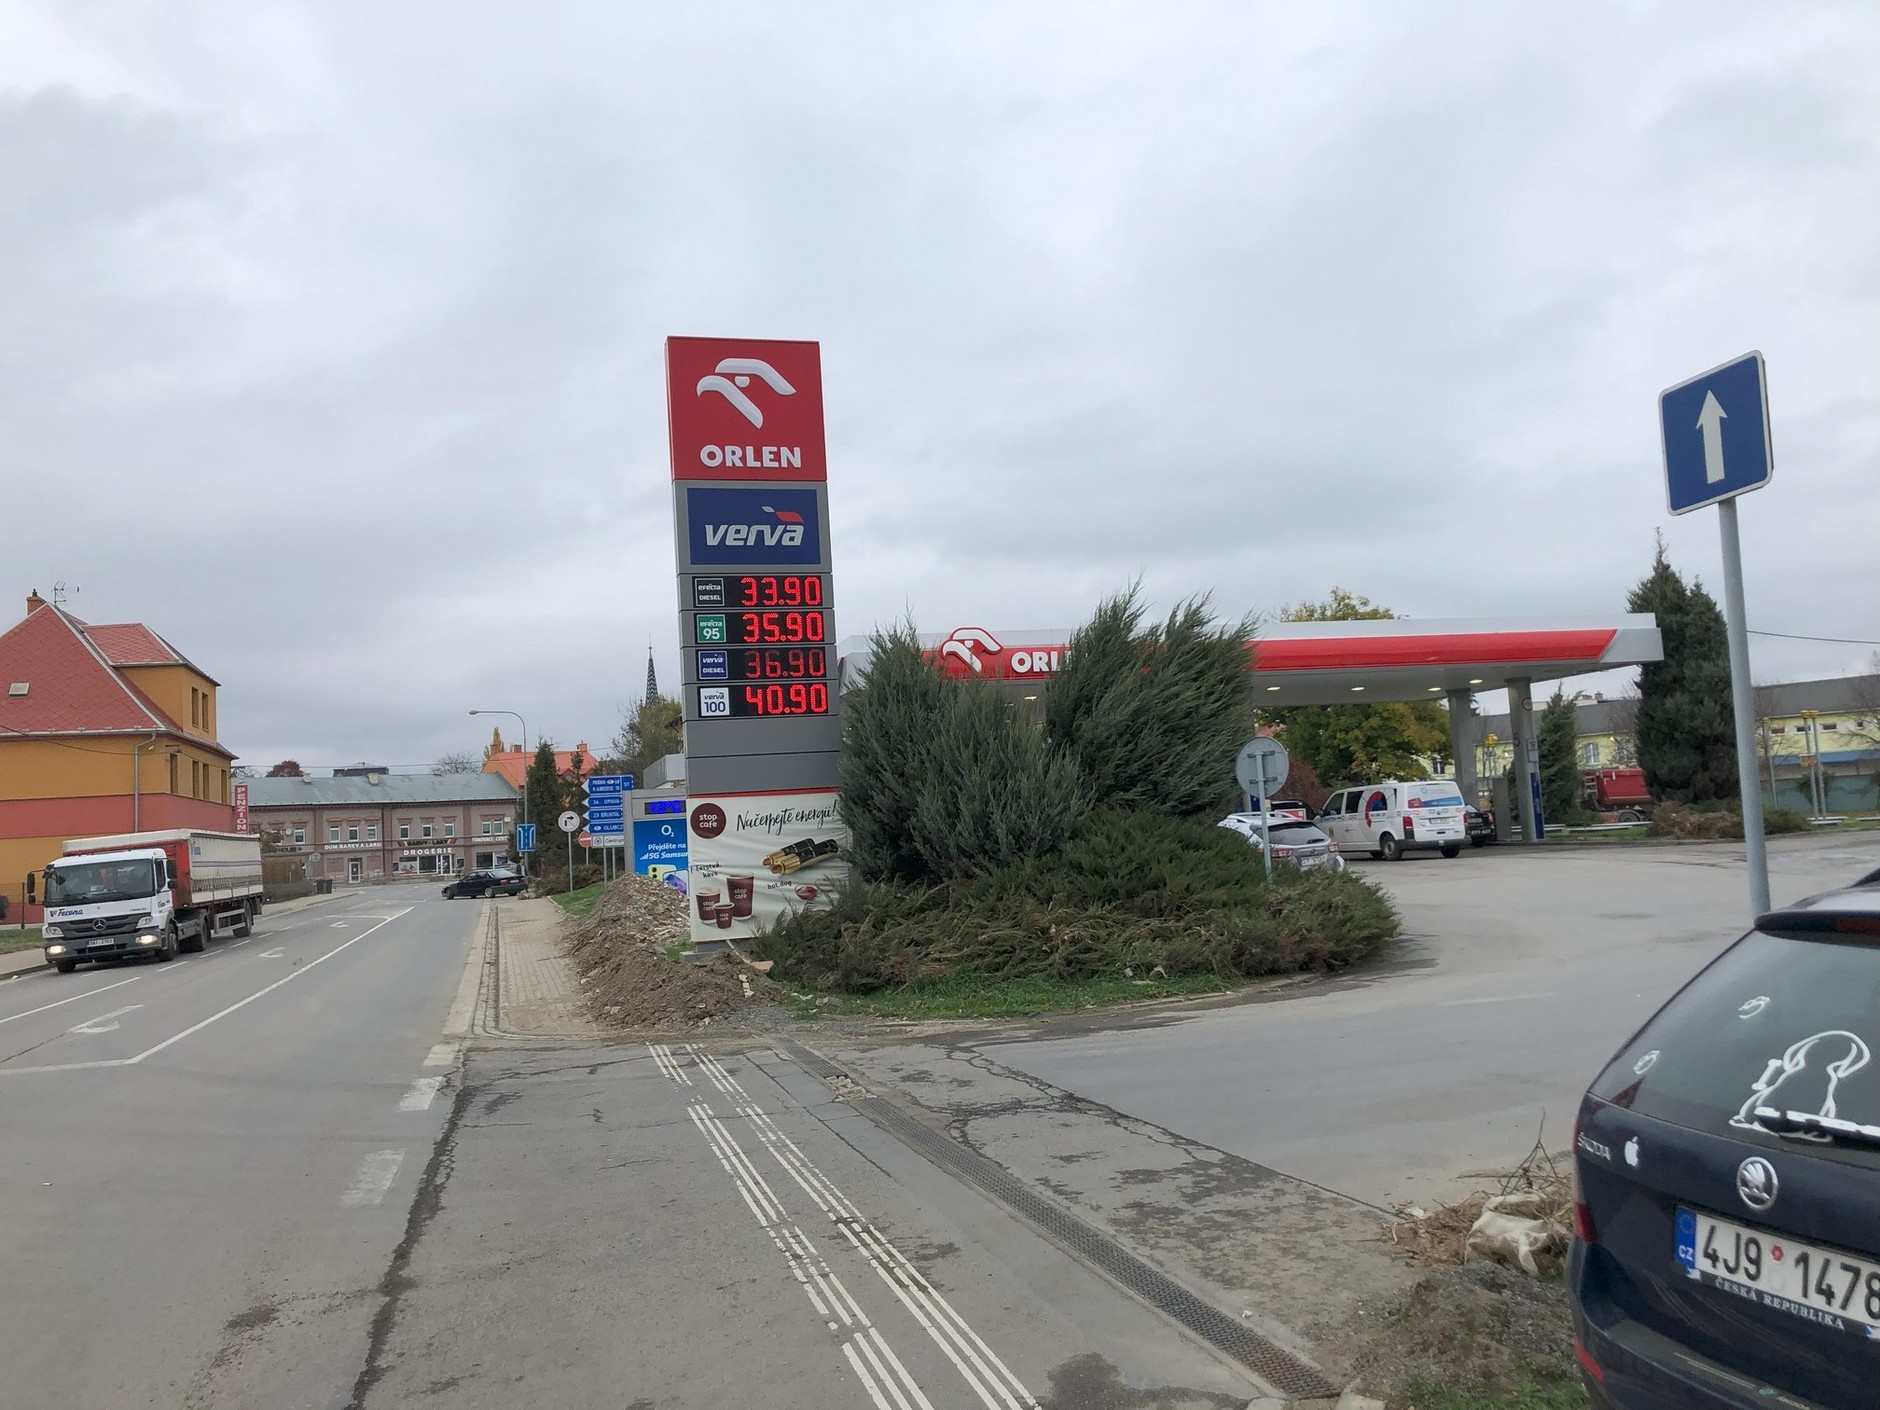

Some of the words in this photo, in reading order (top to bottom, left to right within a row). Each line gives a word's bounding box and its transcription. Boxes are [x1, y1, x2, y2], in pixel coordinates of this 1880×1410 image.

[700, 444, 802, 468] ORLEN
[704, 524, 805, 546] verva
[740, 576, 821, 606] 33.90
[703, 628, 720, 640] 95
[742, 612, 824, 642] 35.90
[744, 648, 826, 679] 36.90
[1011, 651, 1072, 674] ORL
[704, 702, 726, 712] 100
[745, 683, 827, 714] 40.90
[236, 787, 246, 830] PENZION
[736, 807, 796, 836] Načerpejte
[403, 847, 453, 856] DROGERIE
[648, 843, 676, 851] Přejděte
[1678, 1244, 1695, 1260] CZ
[1702, 1224, 1762, 1282] 4J9
[1794, 1250, 1880, 1320] 1478
[1714, 1277, 1758, 1301] ČESKÁ
[1764, 1294, 1846, 1330] REPUBLIKA
